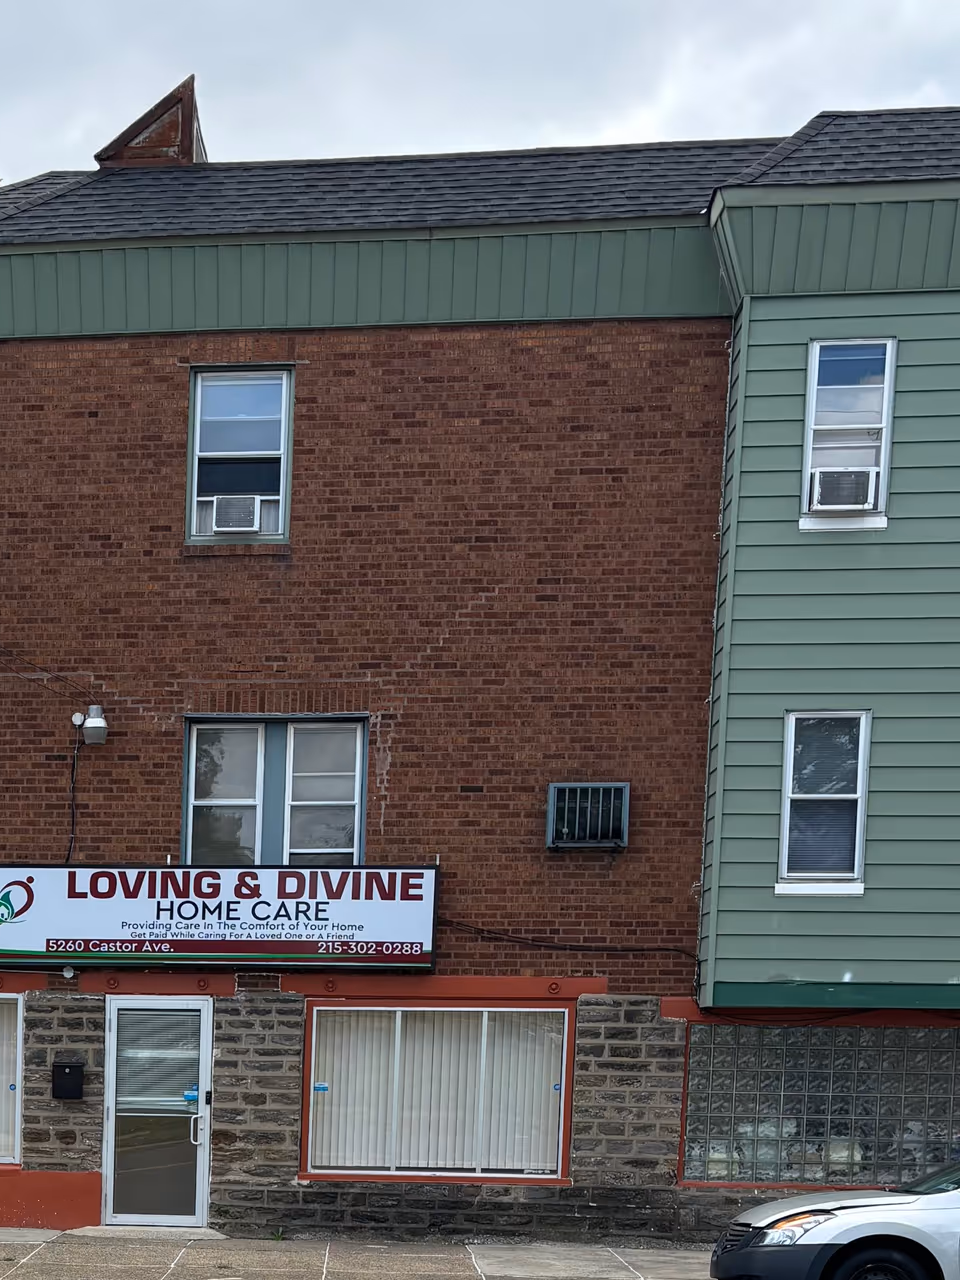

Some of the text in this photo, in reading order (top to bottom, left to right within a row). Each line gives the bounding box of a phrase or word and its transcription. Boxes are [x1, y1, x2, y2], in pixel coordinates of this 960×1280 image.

[67, 870, 425, 901] LOVING & DIVINE
[156, 900, 330, 921] HOME CARE
[121, 921, 364, 932] Providing Care In The Comfort of Your Home
[130, 931, 147, 939] Get
[148, 931, 168, 939] Paid
[169, 931, 195, 939] While
[197, 931, 227, 941] Caring
[229, 931, 244, 940] For
[245, 932, 253, 940] A
[254, 931, 282, 940] Loved
[284, 932, 303, 940] One
[317, 932, 324, 940] A
[326, 932, 355, 941] Friend
[48, 940, 422, 954] 5260 Castor Ave. 215-302-0288
